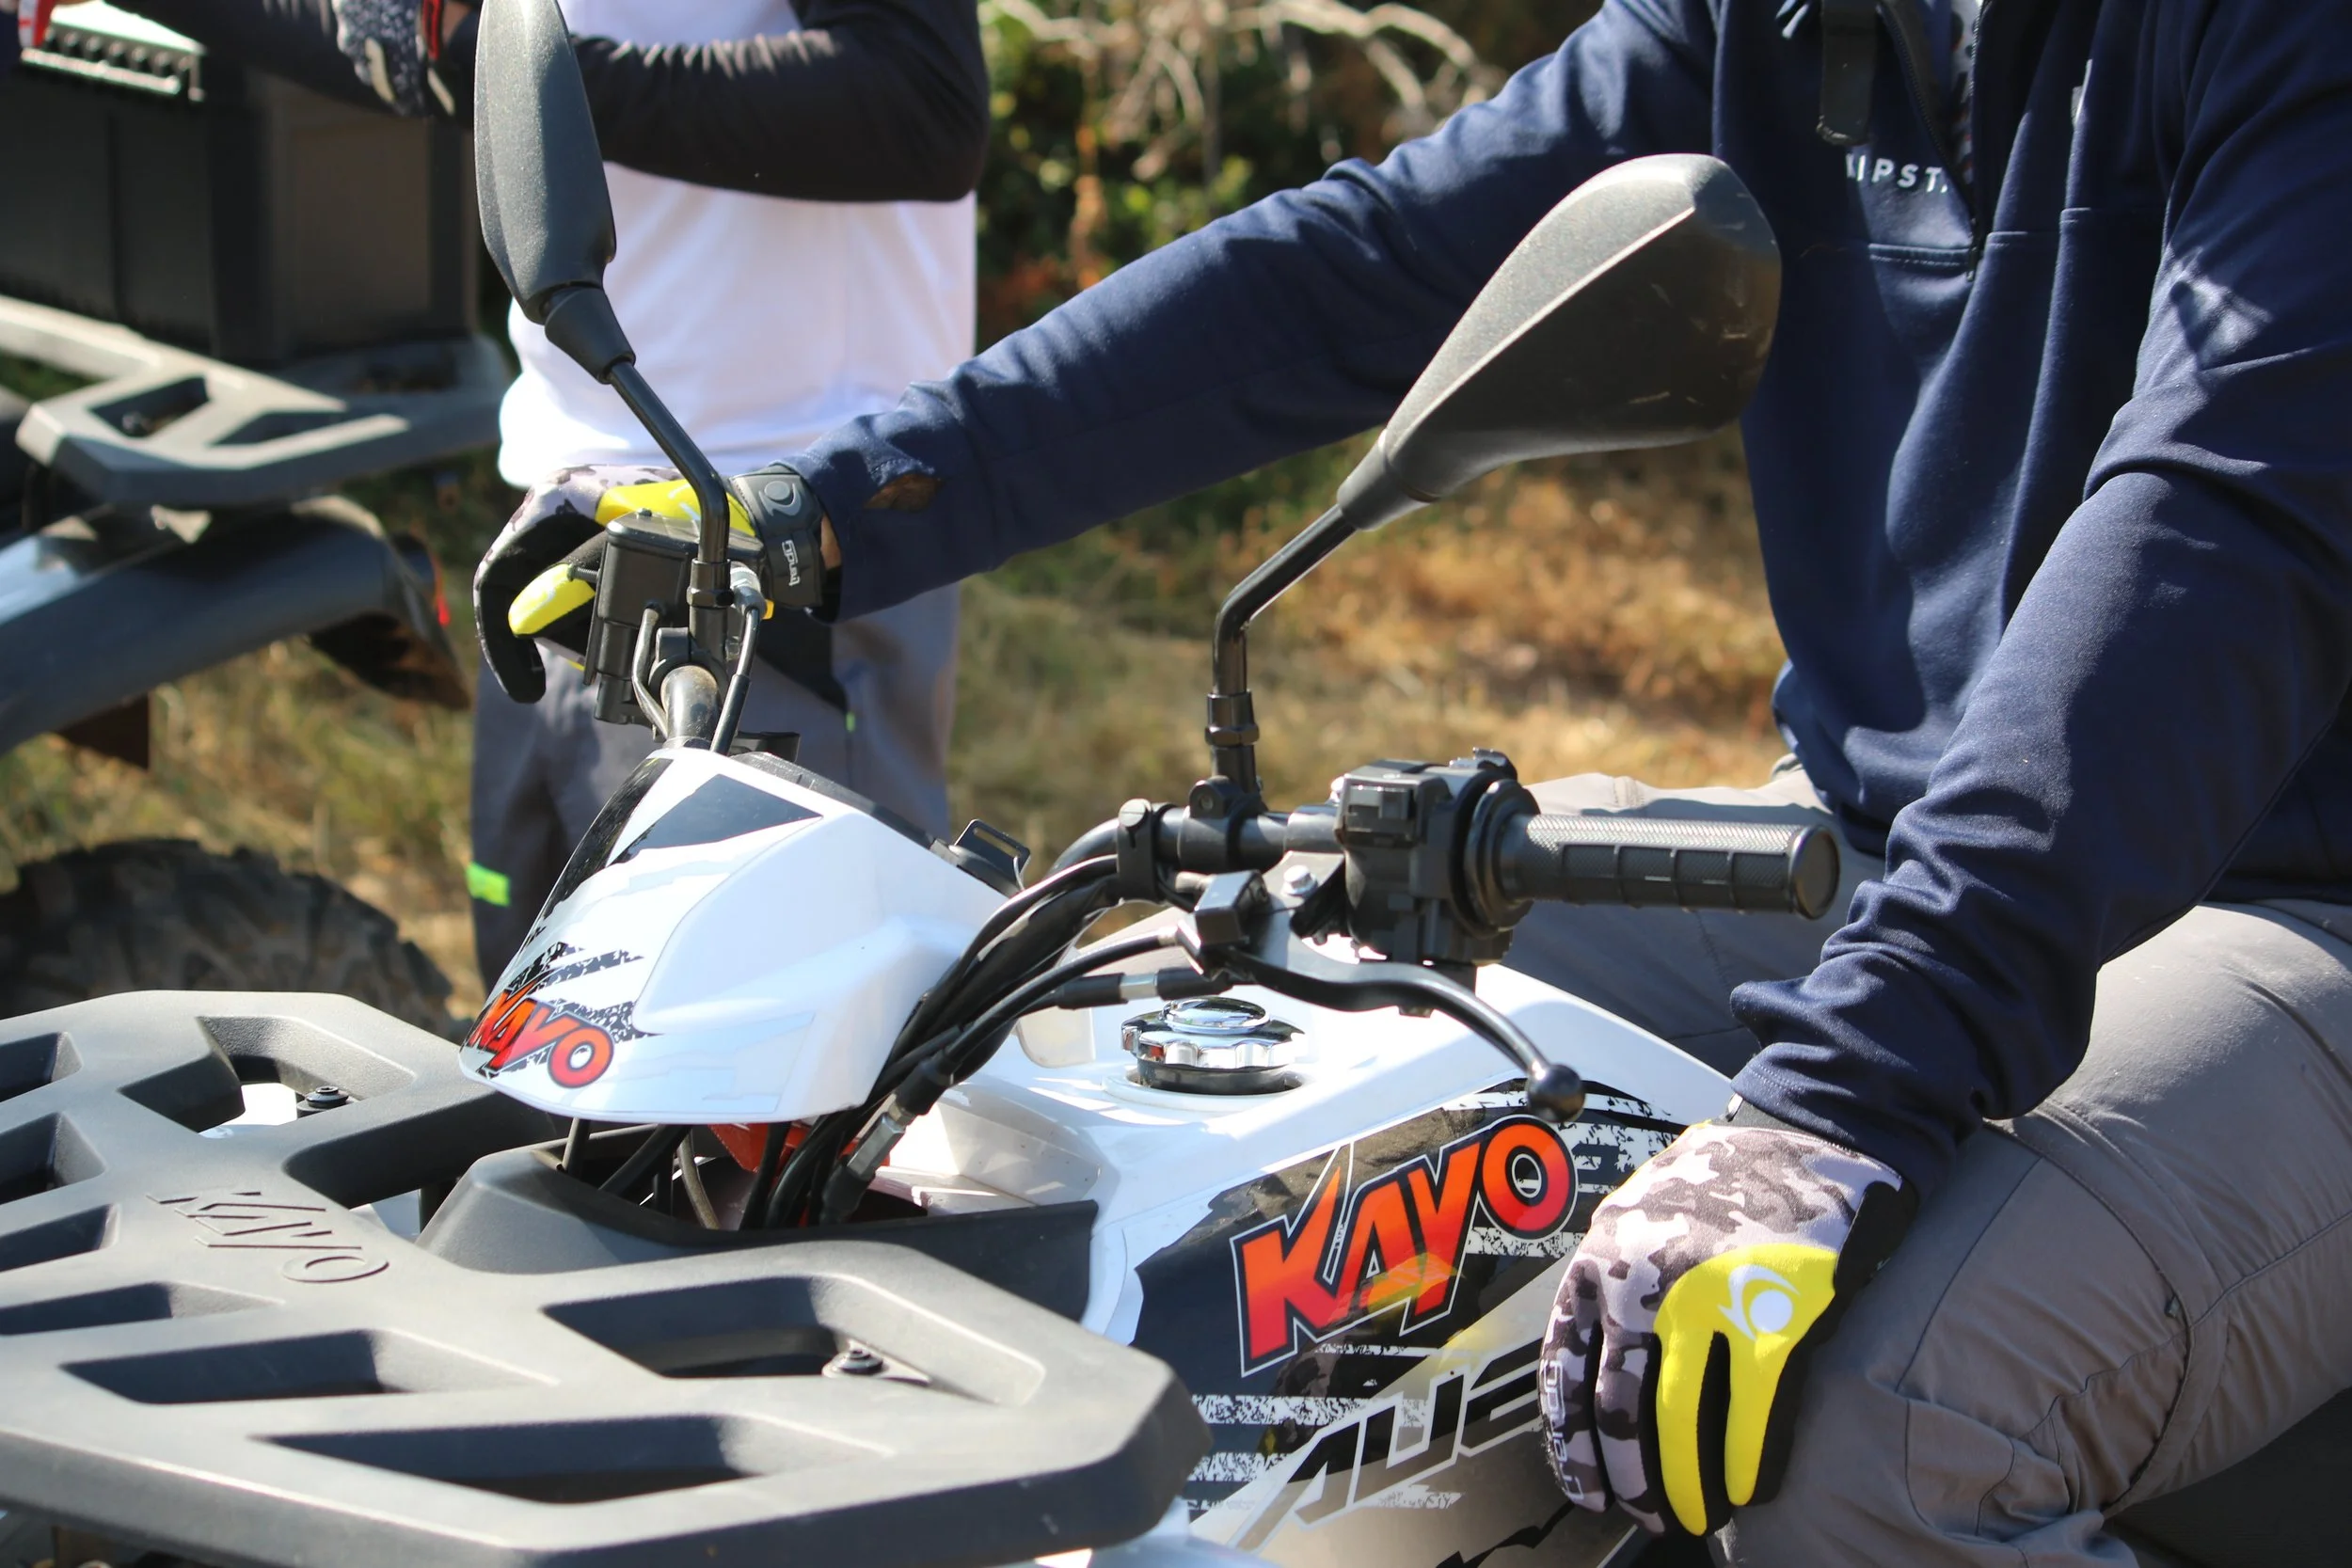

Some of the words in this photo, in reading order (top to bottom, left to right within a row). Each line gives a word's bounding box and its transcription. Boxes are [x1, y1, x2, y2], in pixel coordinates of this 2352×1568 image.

[1846, 153, 1948, 193] KIPST
[465, 974, 615, 1089] KAYO
[1232, 1116, 1579, 1376] KAYO
